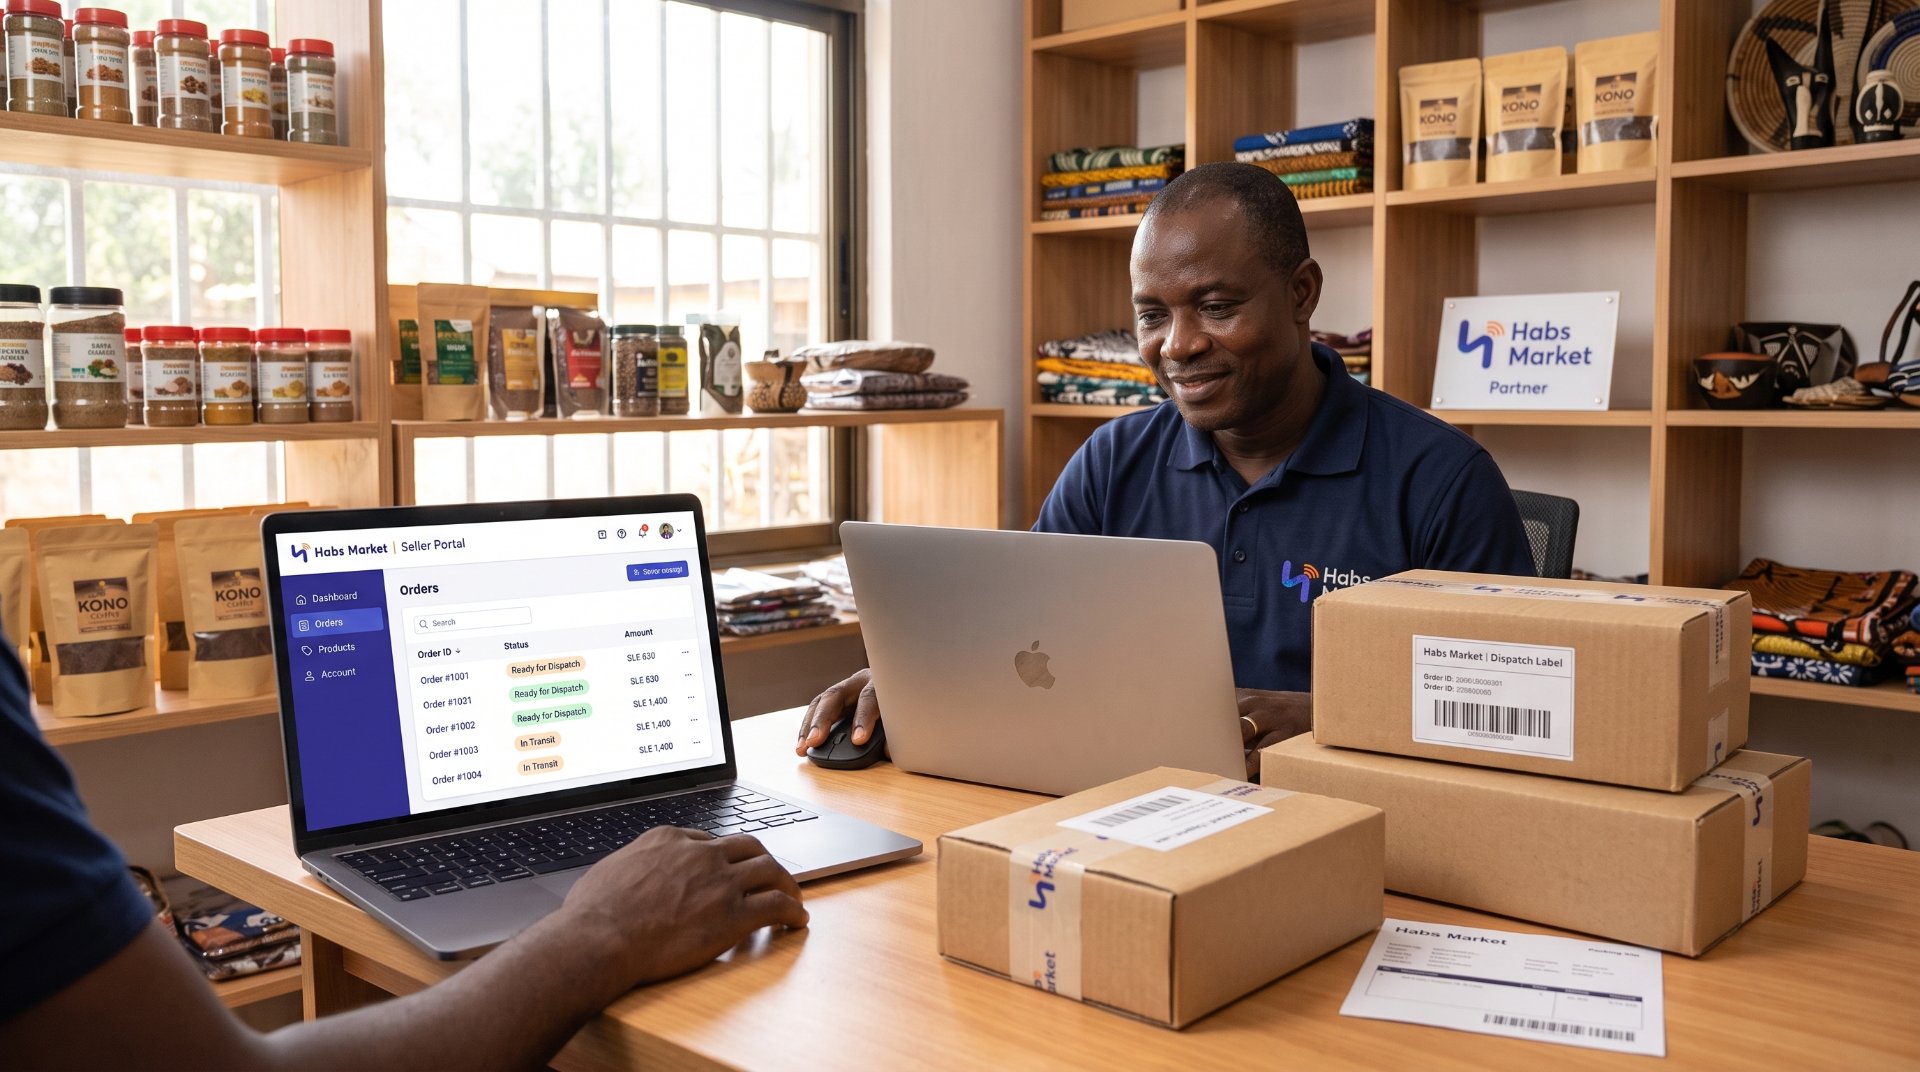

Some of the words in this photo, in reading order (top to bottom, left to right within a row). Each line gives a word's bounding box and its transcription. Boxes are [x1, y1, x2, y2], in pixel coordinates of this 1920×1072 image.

[1595, 89, 1634, 103] KONO
[1502, 99, 1539, 113] KONO
[1420, 112, 1456, 125] KONO
[1512, 321, 1570, 341] Habs
[1509, 345, 1592, 366] Market
[1490, 380, 1548, 394] Partner
[314, 546, 345, 558] Habs
[348, 543, 388, 555] Market
[401, 541, 431, 552] Seller
[434, 538, 466, 550] Portal
[215, 586, 262, 602] KONO
[400, 584, 439, 596] Orders
[312, 591, 358, 603] Dashboard
[78, 597, 128, 613] KONO
[315, 619, 343, 628] Orders
[432, 618, 456, 627] Search
[624, 629, 653, 638] Amount
[318, 643, 355, 654] Products
[504, 641, 529, 650] Status
[417, 649, 441, 659] Order
[443, 648, 452, 656] ID
[627, 653, 641, 662] SLE
[642, 651, 656, 660] 630
[1423, 647, 1447, 658] Habs
[1449, 650, 1484, 661] Market
[1490, 653, 1534, 665] Dispatch
[1536, 657, 1563, 668] Label
[321, 668, 356, 679] Account
[511, 665, 535, 674] Ready
[536, 663, 547, 672] for
[548, 660, 581, 671] Dispatch
[420, 675, 443, 684] Order
[445, 672, 469, 682] #1001
[630, 676, 644, 685] SLE
[1444, 675, 1454, 683] ID:
[514, 688, 538, 698] Ready
[539, 687, 550, 695] for
[551, 683, 584, 694] Dispatch
[1423, 683, 1443, 692] Order
[1445, 685, 1455, 693] ID:
[423, 700, 445, 709] Order
[633, 699, 647, 708] SLE
[648, 697, 668, 707] 1,400
[517, 712, 541, 723] Ready
[542, 711, 553, 719] for
[554, 706, 587, 718] Dispatch
[426, 725, 448, 735] Order
[450, 721, 476, 731] #1002
[636, 722, 650, 731] SLE
[651, 719, 671, 730] 1,400
[520, 740, 528, 748] In
[529, 735, 556, 745] Transit
[639, 745, 653, 754] SLE
[654, 742, 674, 752] 1,400
[429, 750, 452, 760] Order
[453, 745, 479, 756] #1003
[523, 764, 531, 772] In
[532, 759, 559, 770] Transit
[432, 775, 455, 785] Order
[457, 770, 482, 781] #1004
[1395, 926, 1441, 937] Habs
[1447, 933, 1509, 946] Market
[1045, 951, 1056, 994] arket
